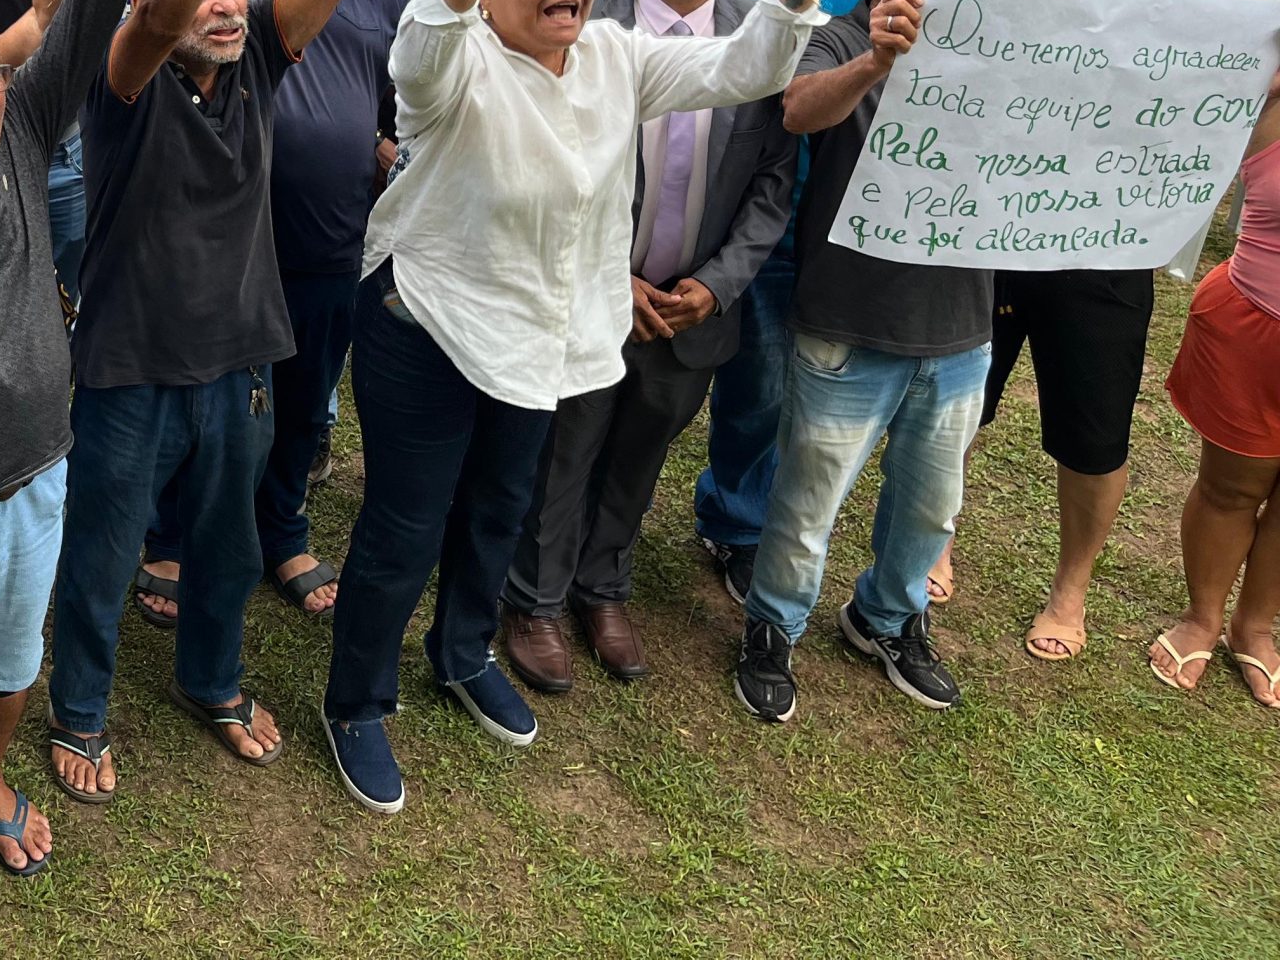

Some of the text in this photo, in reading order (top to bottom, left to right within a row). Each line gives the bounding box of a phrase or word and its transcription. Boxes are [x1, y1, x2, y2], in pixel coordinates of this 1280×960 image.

[1133, 44, 1260, 81] agradecer
[906, 69, 984, 118] toda
[1007, 96, 1112, 133] equipe
[1136, 98, 1185, 127] do
[870, 122, 1211, 183] Pela nossa estrada
[862, 182, 881, 202] e
[998, 190, 1102, 218] nossa
[849, 215, 907, 248] que
[918, 222, 963, 257] foi
